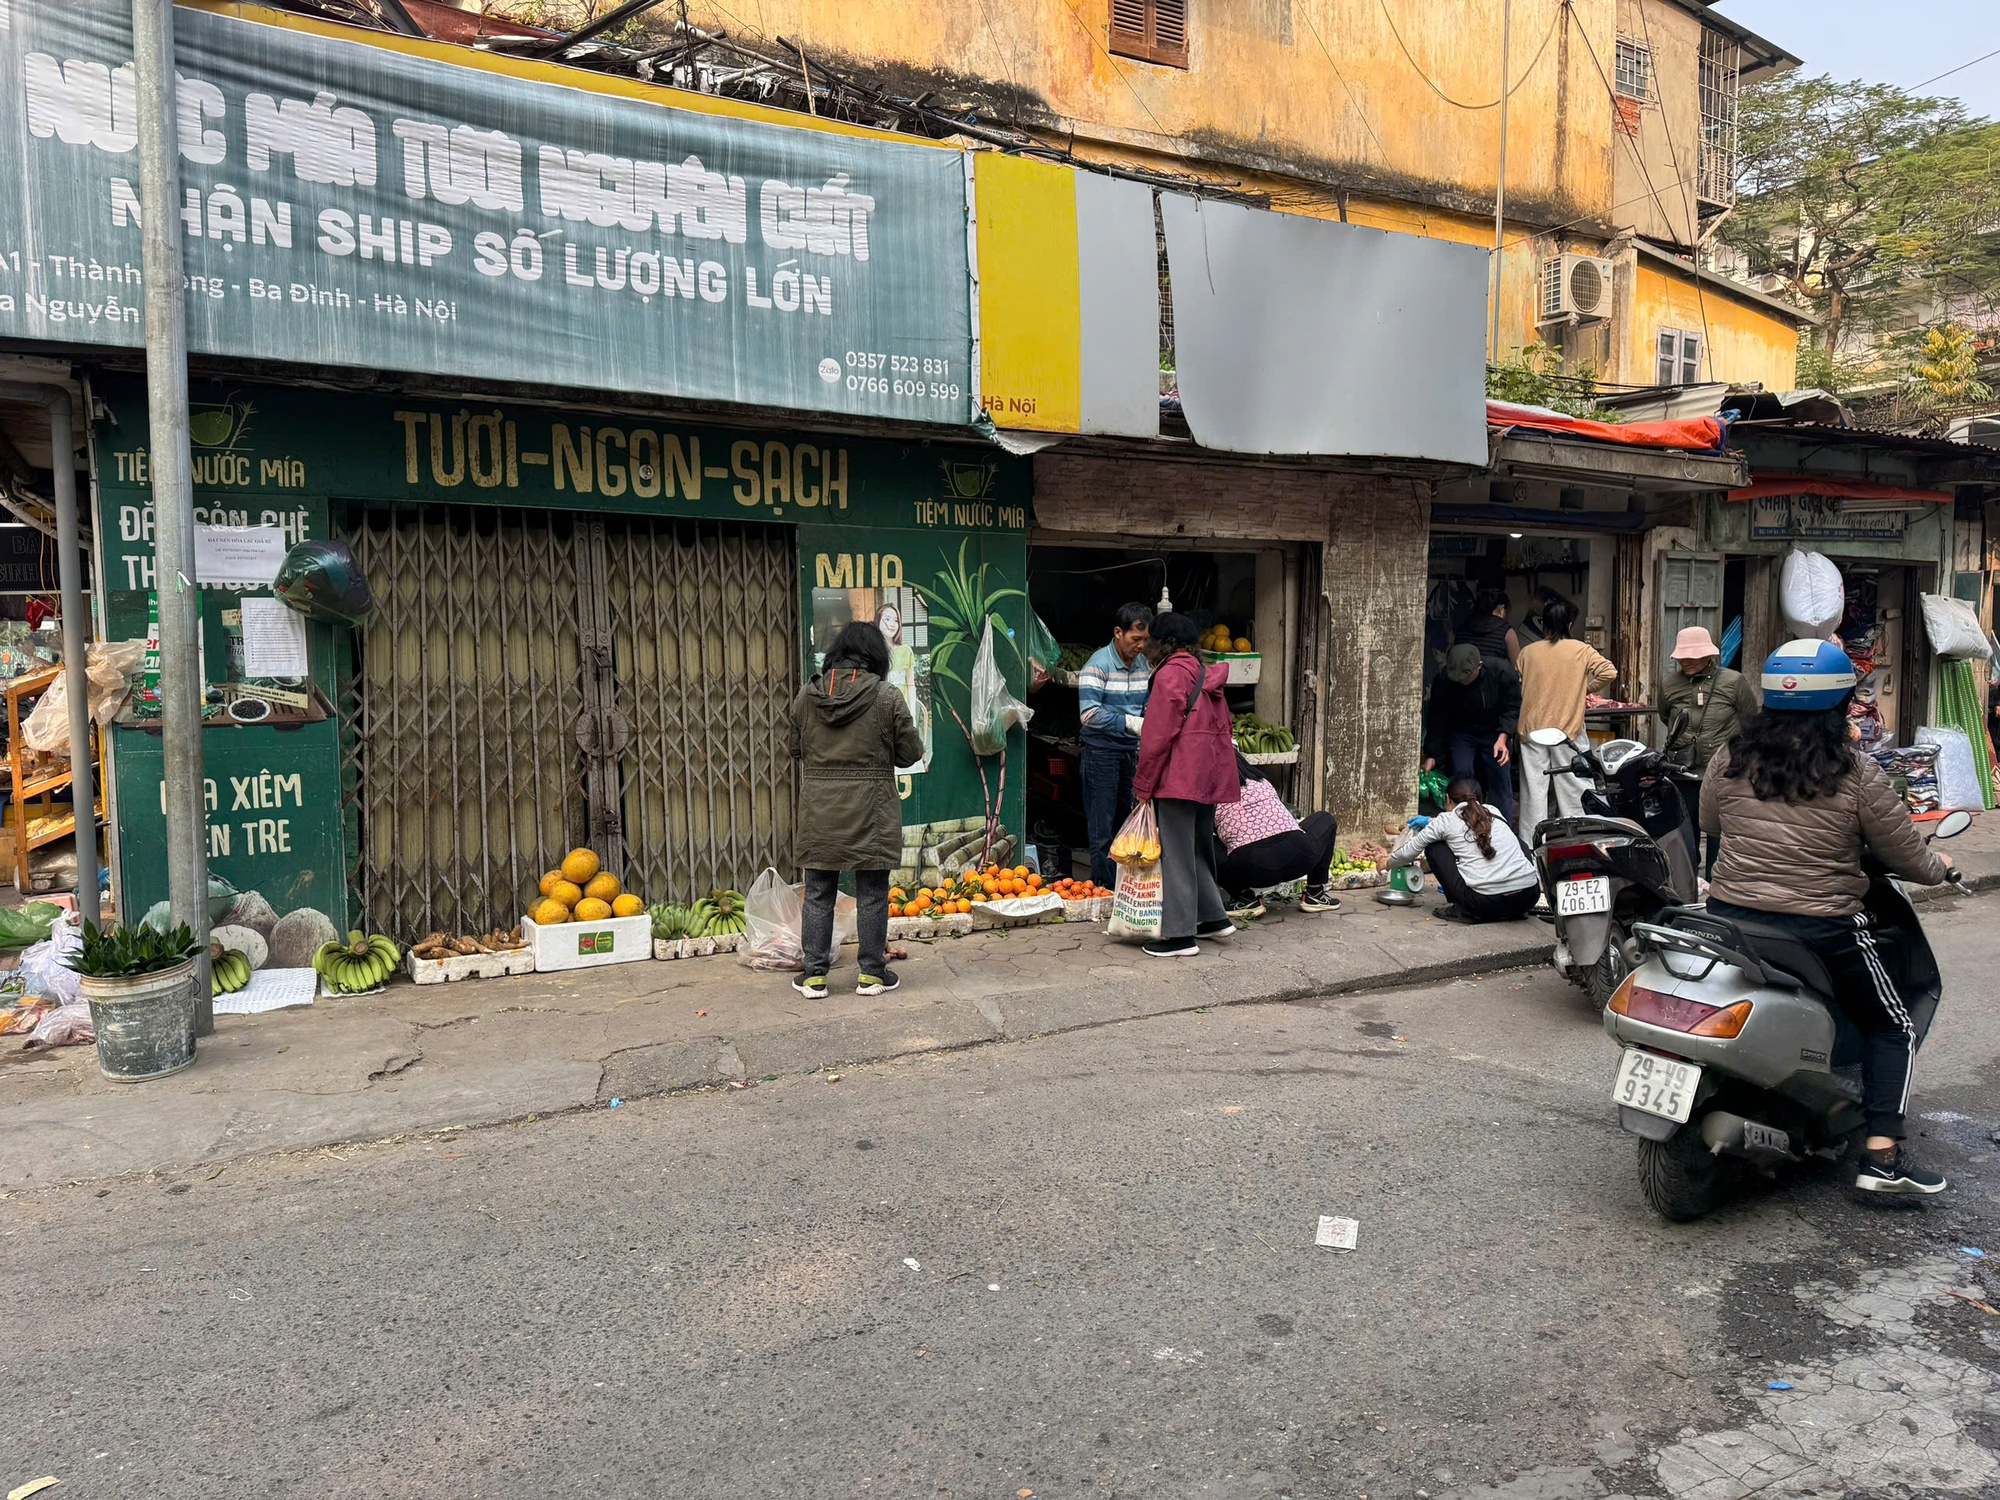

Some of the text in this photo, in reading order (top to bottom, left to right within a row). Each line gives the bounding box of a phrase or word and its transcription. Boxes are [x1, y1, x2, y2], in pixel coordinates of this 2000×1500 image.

[317, 208, 453, 267] SHIP
[473, 228, 563, 281] SỐ
[565, 242, 727, 304] LƯỢNG
[745, 259, 832, 315] LỚN
[48, 254, 142, 285] Thành
[249, 277, 282, 301] Ba
[289, 283, 351, 309] Đình
[374, 293, 408, 315] Hà
[415, 297, 457, 324] Nội
[25, 292, 140, 325] Nguyễn
[846, 351, 949, 376] 0357 523 831
[846, 375, 960, 400] 0766 609 599
[982, 394, 1037, 417] Hà Nội
[113, 447, 154, 486] TIỆ
[260, 455, 305, 488] MÍA
[914, 497, 1025, 529] TIỆM NƯỚC MÍA
[230, 768, 302, 811] XIÊM
[242, 819, 292, 856] TRE
[1561, 895, 1605, 912] 406.11
[1564, 879, 1601, 897] 29-E2
[1125, 914, 1158, 926] CHANGING
[1682, 928, 1723, 942] HONDA
[1623, 1079, 1682, 1116] 9345
